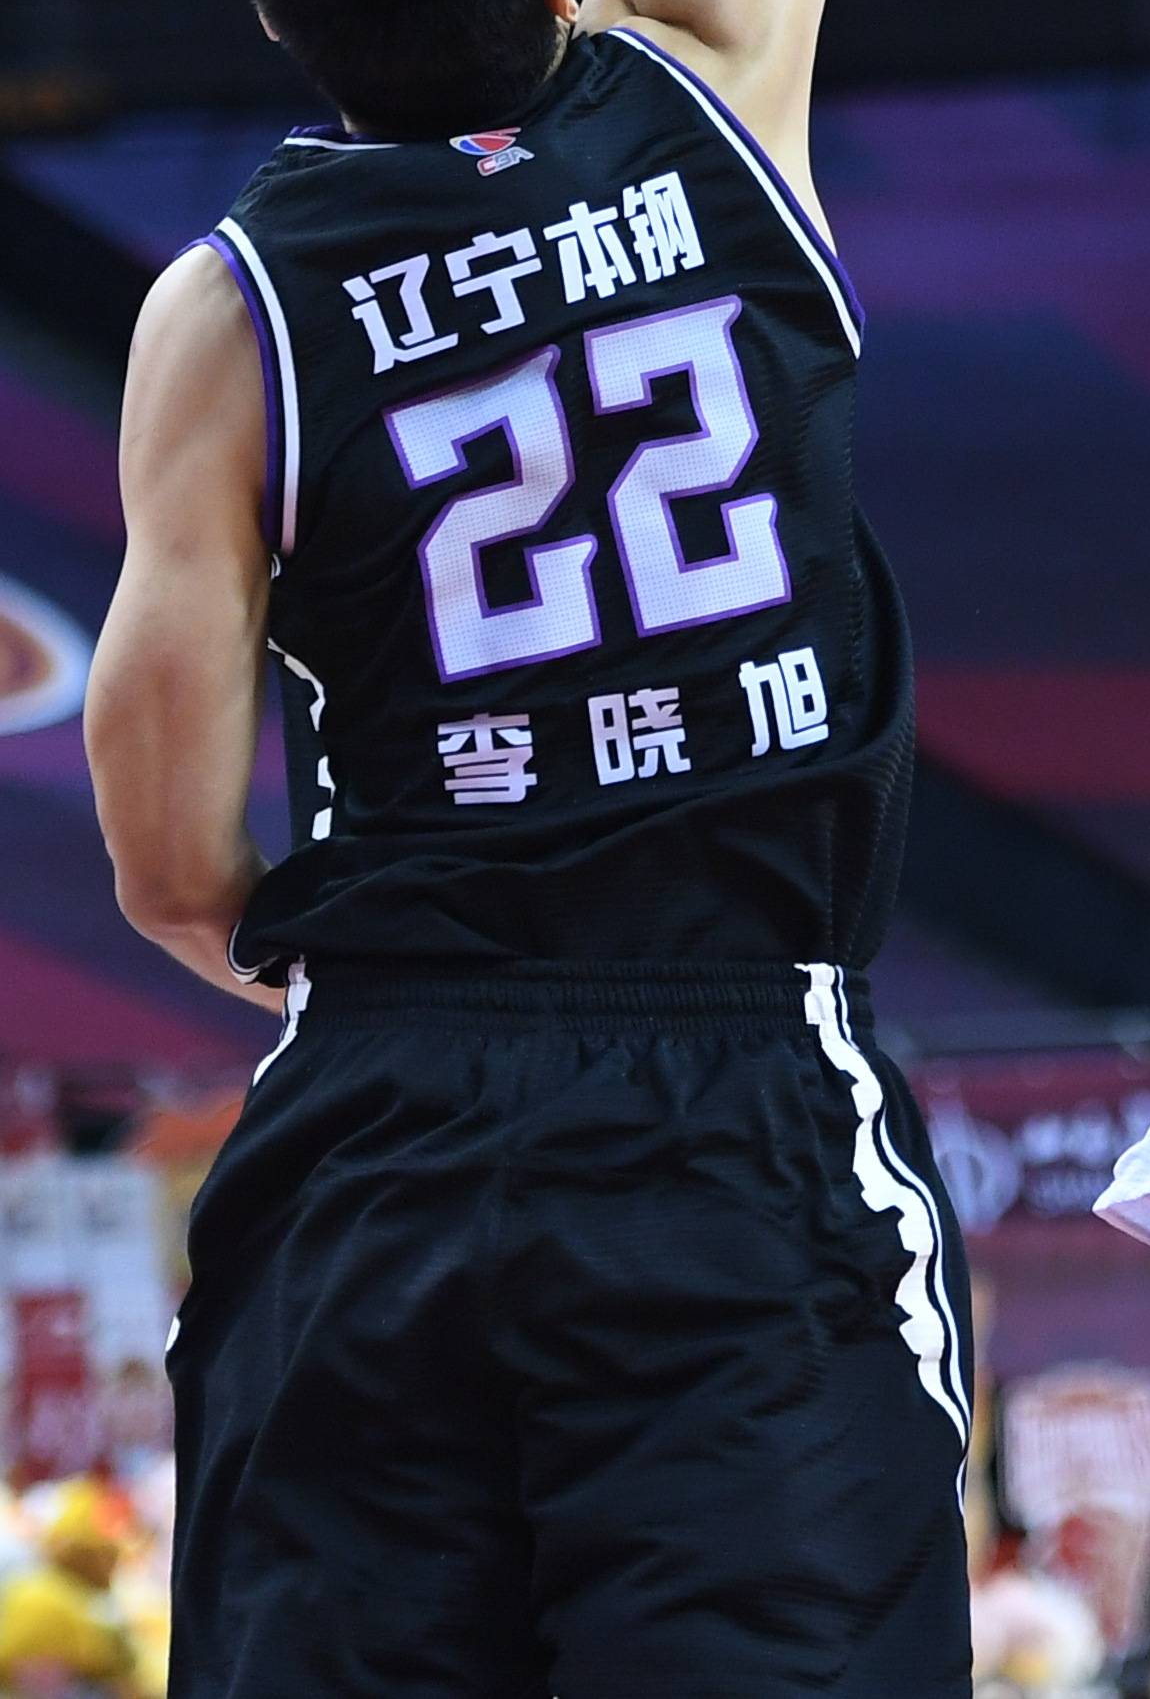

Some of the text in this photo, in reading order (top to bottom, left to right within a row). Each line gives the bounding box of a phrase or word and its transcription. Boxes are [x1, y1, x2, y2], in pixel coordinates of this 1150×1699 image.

[477, 146, 535, 176] CBA
[341, 171, 705, 375] 辽宁本钢
[381, 295, 792, 683] 22
[437, 647, 829, 805] 李晓旭
